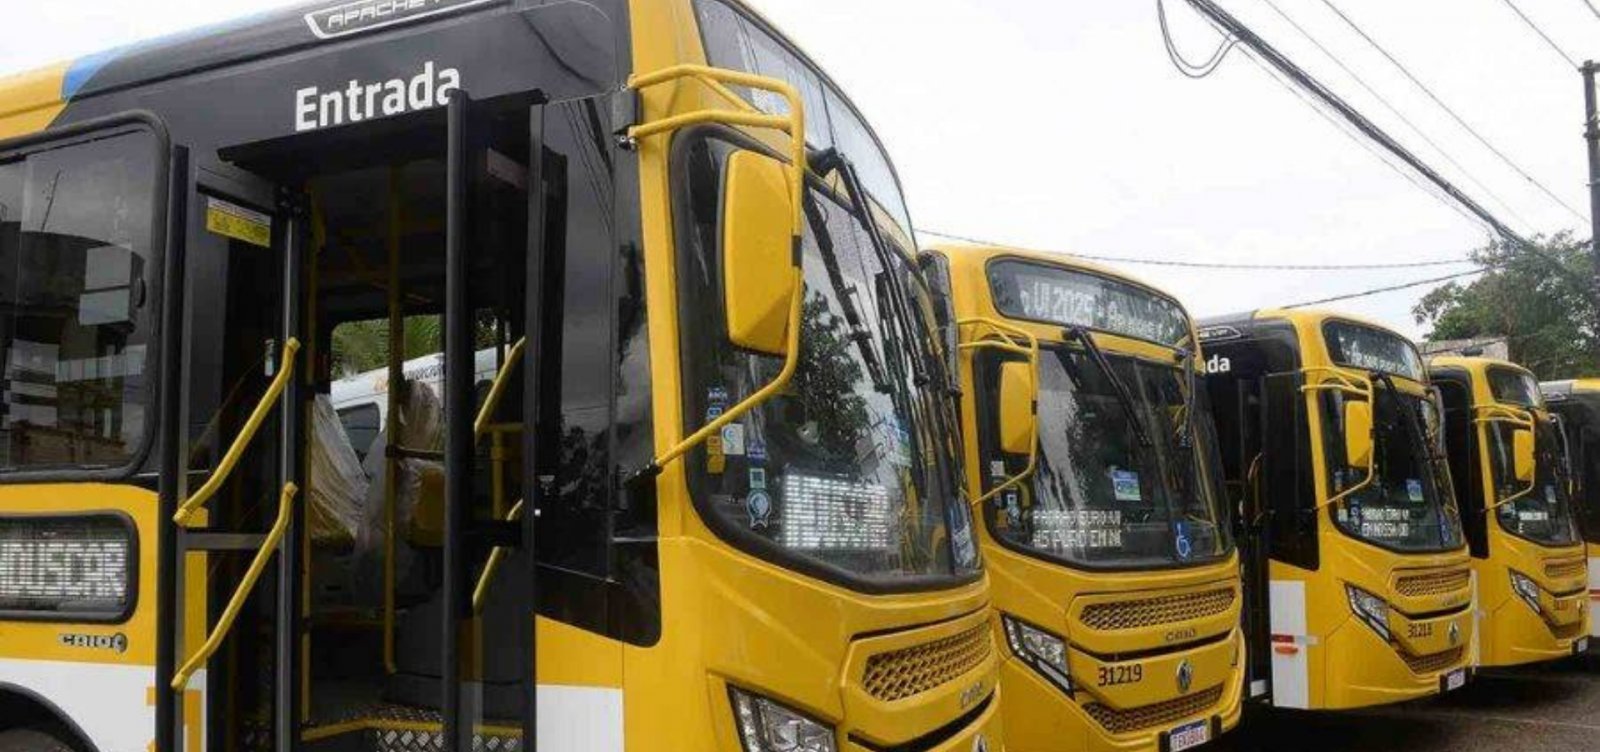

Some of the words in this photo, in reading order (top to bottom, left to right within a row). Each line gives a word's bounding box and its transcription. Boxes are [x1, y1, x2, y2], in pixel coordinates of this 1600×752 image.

[296, 61, 460, 132] Entrada
[1202, 354, 1231, 374] da
[1098, 664, 1142, 687] 31219
